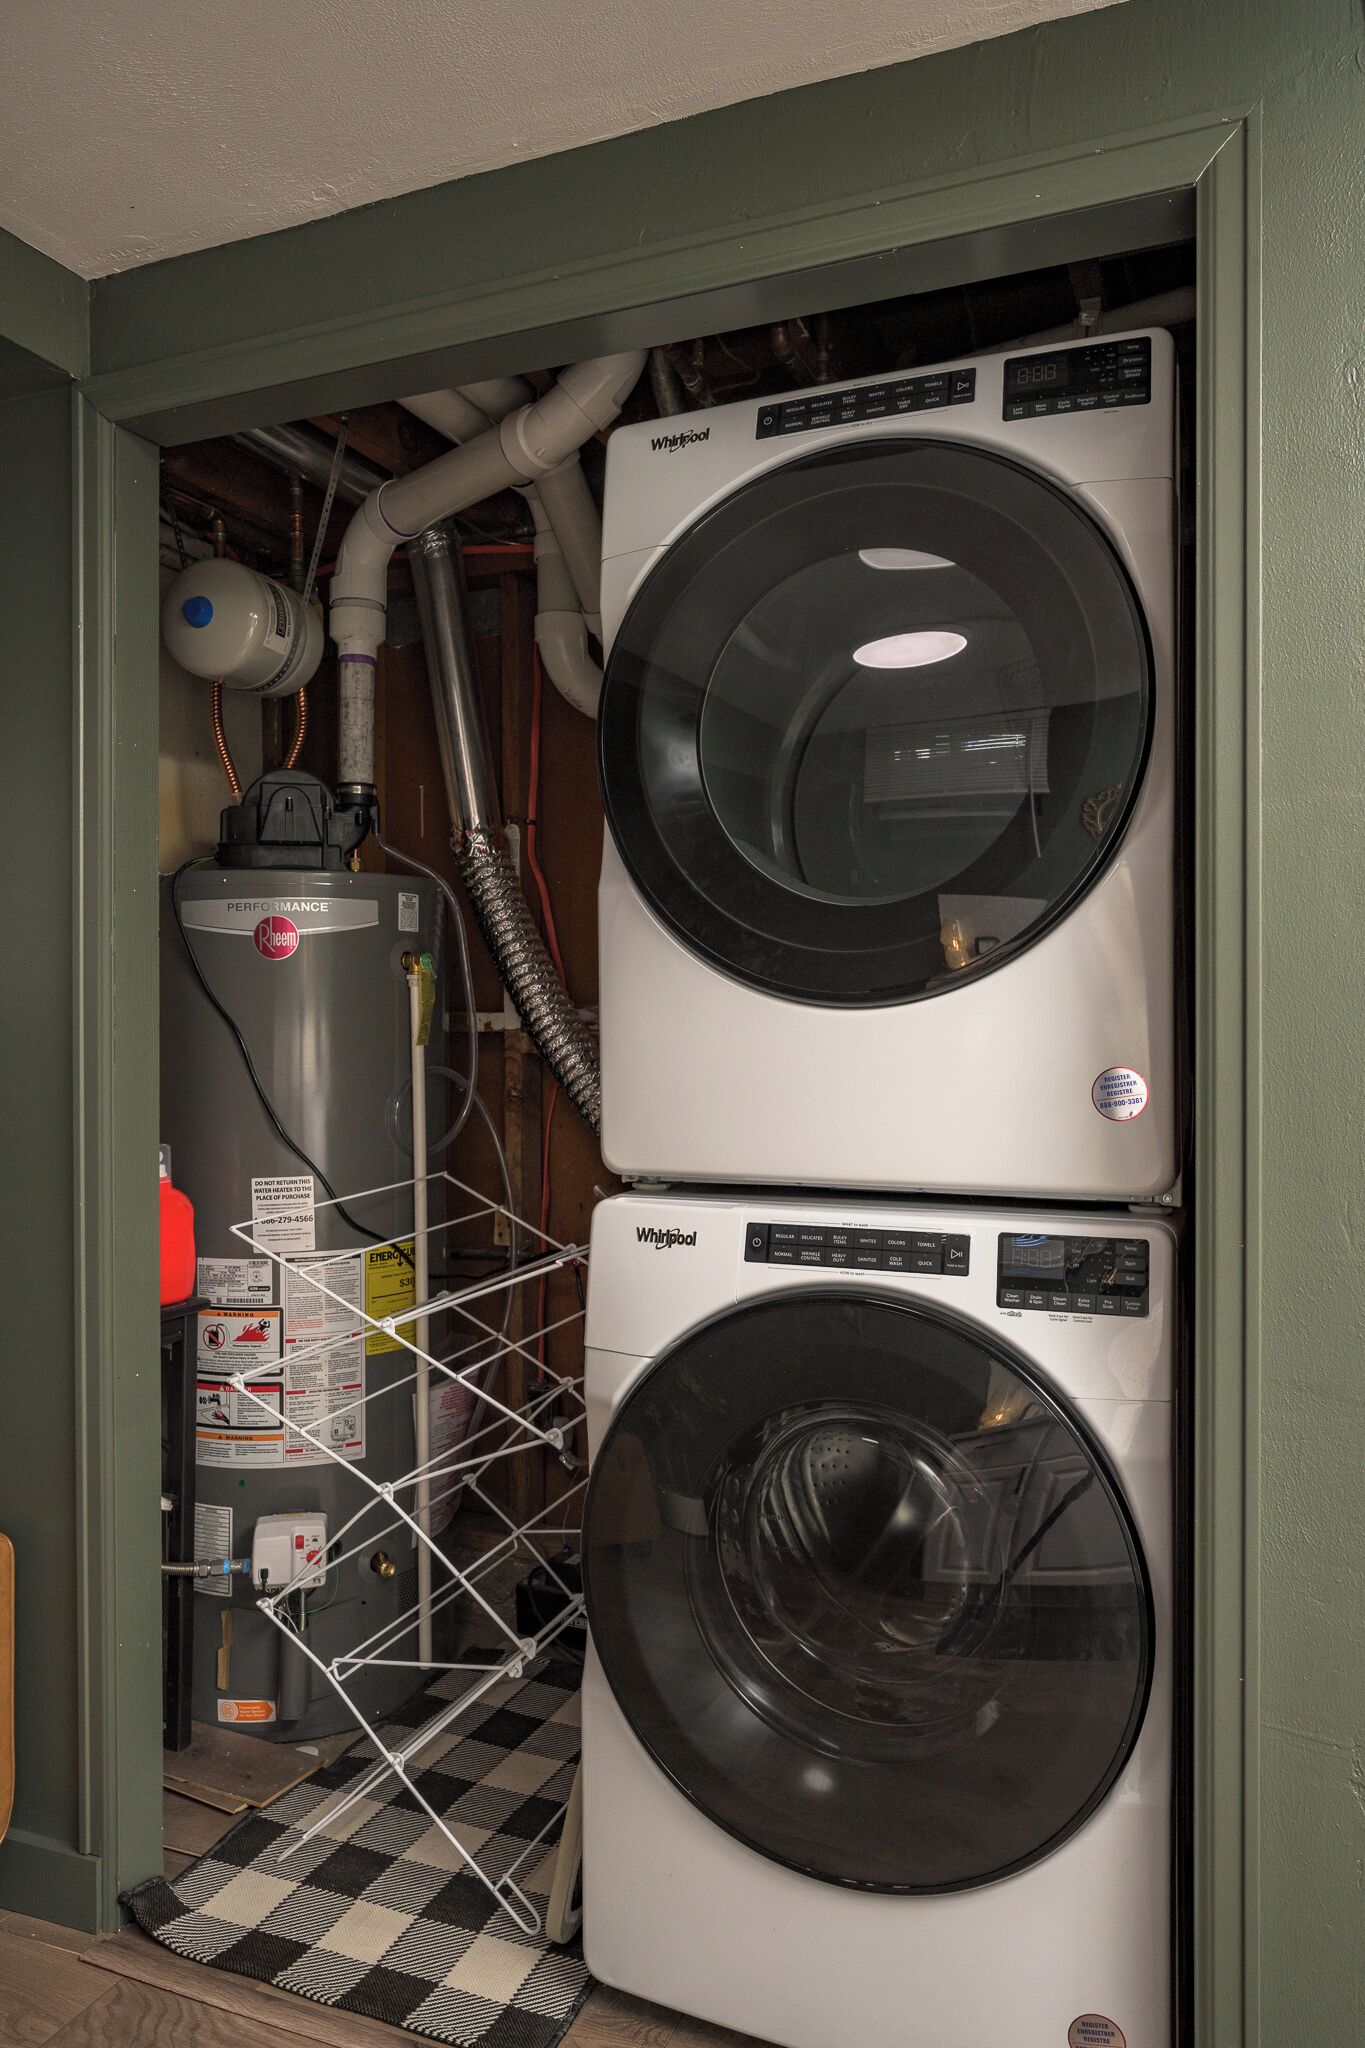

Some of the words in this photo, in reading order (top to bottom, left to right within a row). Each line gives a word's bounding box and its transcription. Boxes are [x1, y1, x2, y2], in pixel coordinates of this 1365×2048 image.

[811, 400, 832, 408] DELICATES
[785, 420, 803, 428] NORMAL
[651, 427, 710, 452] Whirlpool
[227, 902, 329, 912] PERFORMANCE
[259, 915, 296, 952] Rheem
[1104, 1074, 1131, 1082] REGISTER
[636, 1227, 697, 1249] Whirlpool
[1081, 2021, 1109, 2029] REGISTER
